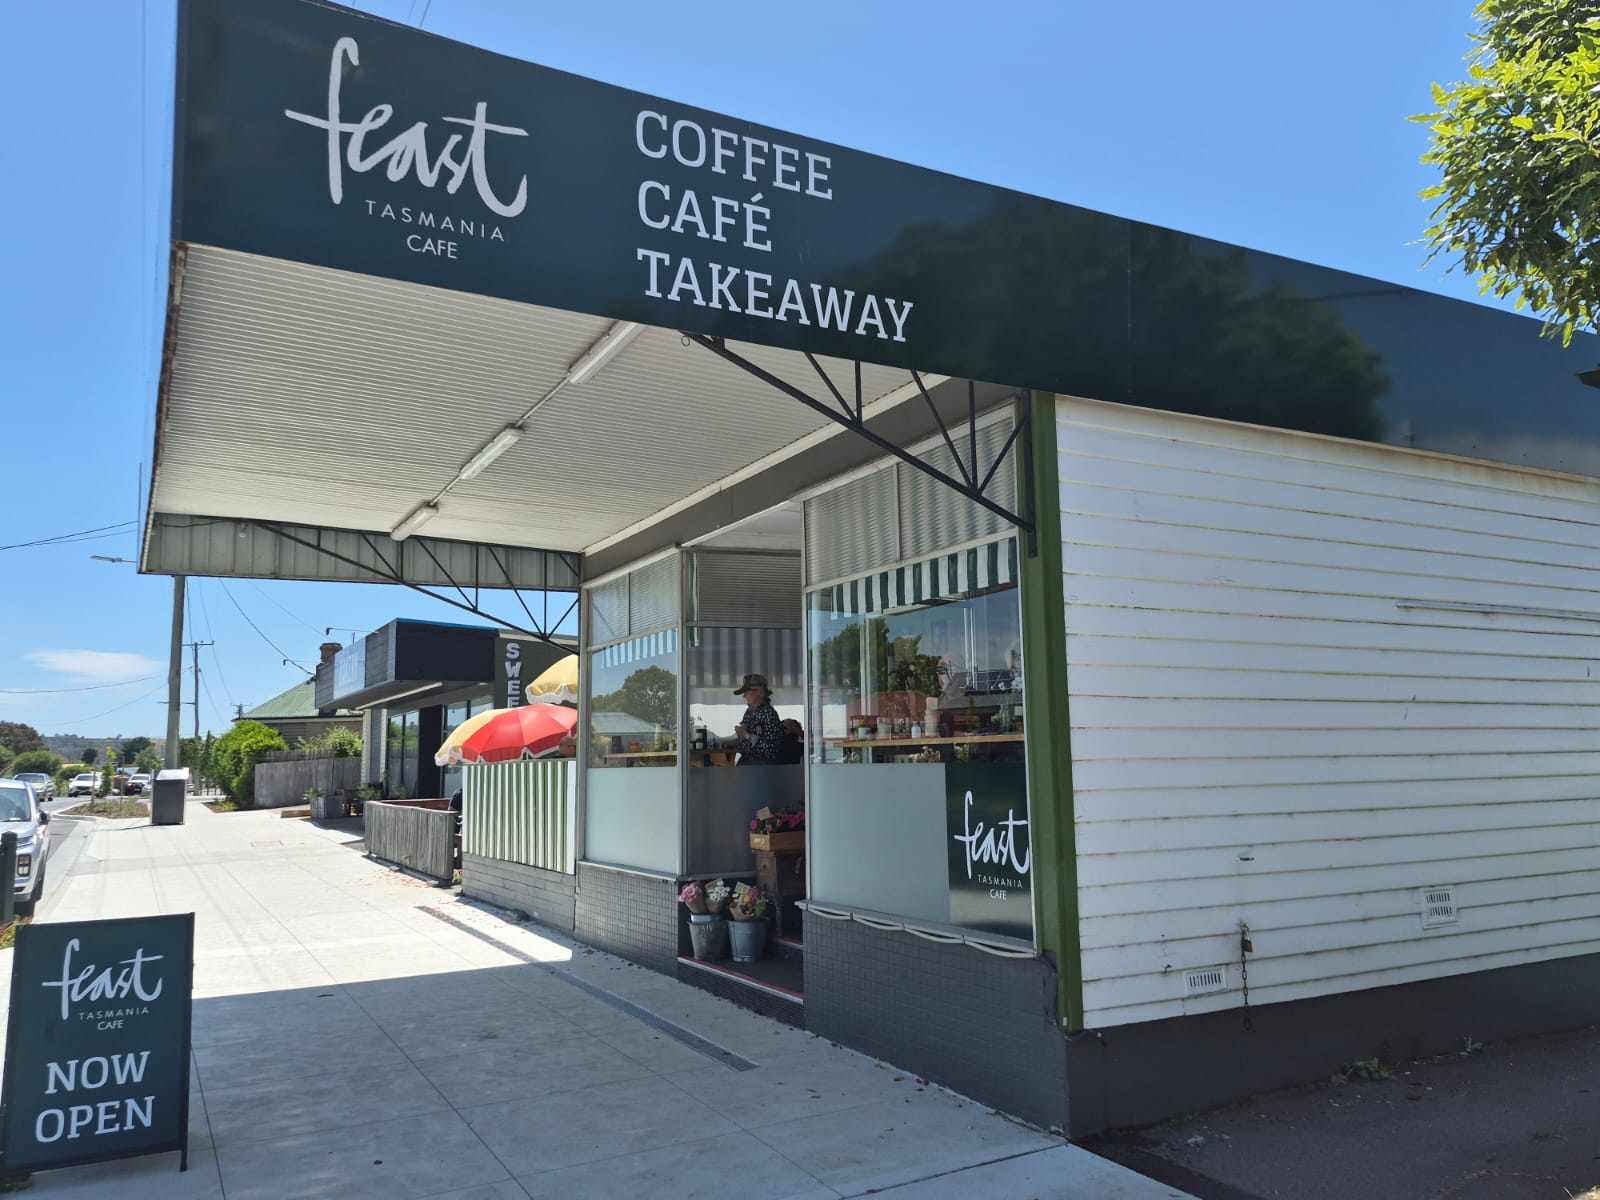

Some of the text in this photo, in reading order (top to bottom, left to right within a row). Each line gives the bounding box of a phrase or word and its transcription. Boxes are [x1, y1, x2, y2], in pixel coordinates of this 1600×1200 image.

[285, 37, 529, 218] feast
[636, 110, 833, 200] COFFEE
[365, 199, 505, 242] TASMANIA
[638, 180, 772, 252] CAFÉ
[406, 234, 458, 259] CAFE
[636, 247, 914, 343] TAKEAWAY
[953, 790, 1030, 879] feast
[977, 874, 1023, 888] TASMANIA
[989, 888, 1007, 900] CAFE
[41, 938, 164, 1021] feast
[79, 1006, 150, 1021] TASMANIA
[97, 1019, 124, 1031] CAFE
[44, 1050, 151, 1095] NOW
[35, 1095, 156, 1143] OPEN
